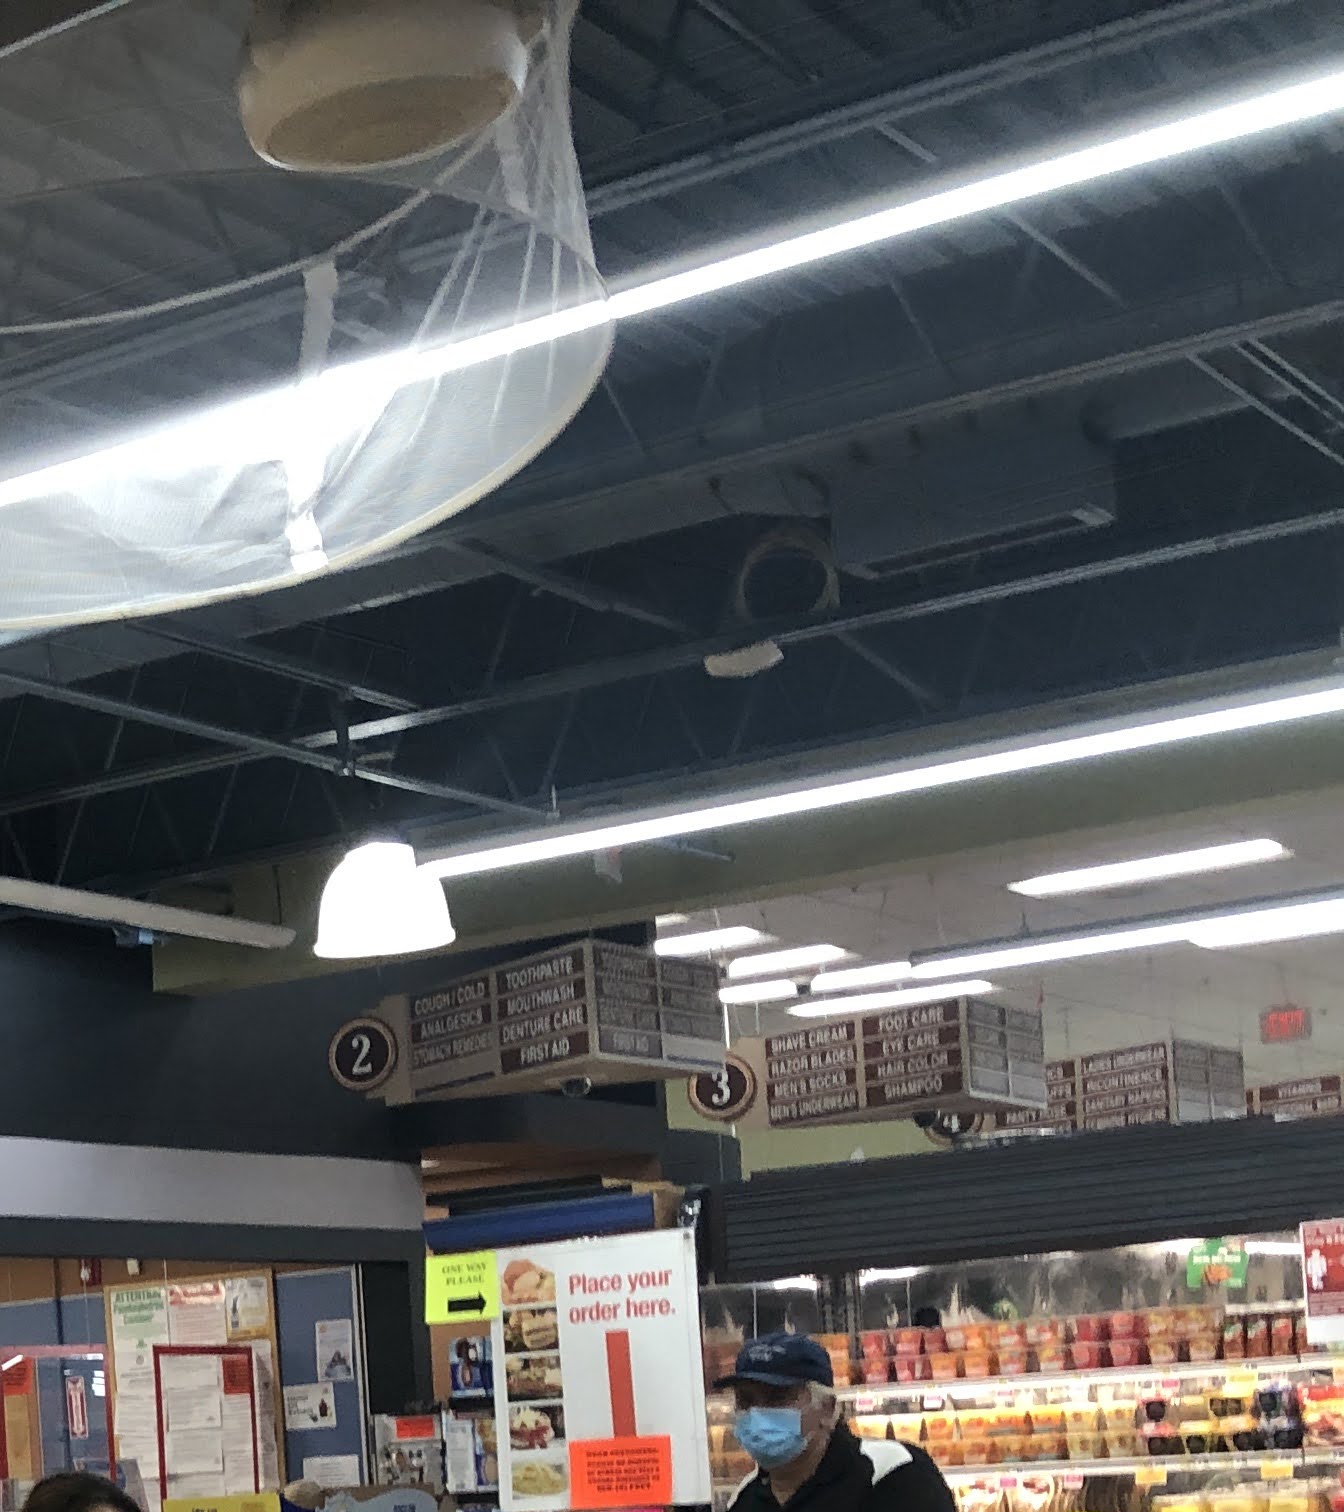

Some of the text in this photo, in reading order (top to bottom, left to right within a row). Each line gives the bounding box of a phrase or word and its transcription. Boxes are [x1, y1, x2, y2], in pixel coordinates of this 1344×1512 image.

[505, 957, 574, 989] TOOTHPASTE
[415, 983, 484, 1016] COUGH COLD
[507, 982, 575, 1015] MOUTHWASH
[421, 1008, 483, 1039] ANALGESICS
[502, 1006, 583, 1043] DENTURE CARE
[879, 1005, 944, 1033] FOOT CARE
[414, 1042, 451, 1065] STOMACH
[520, 1037, 570, 1065] FIRST AID
[771, 1026, 847, 1053] SHAVE CREAM
[882, 1031, 939, 1055] EYE CARE
[352, 1034, 373, 1075] 2
[771, 1049, 854, 1077] RAZOR BLADES
[878, 1052, 948, 1077] HAIR COLOR
[713, 1067, 731, 1106] 3
[809, 1071, 846, 1088] SOCKS
[884, 1075, 942, 1098] SHAMPOO
[442, 1262, 486, 1274] ONE WAY
[446, 1275, 484, 1286] PLEASE
[568, 1269, 673, 1296] Place your
[569, 1296, 676, 1325] order here.
